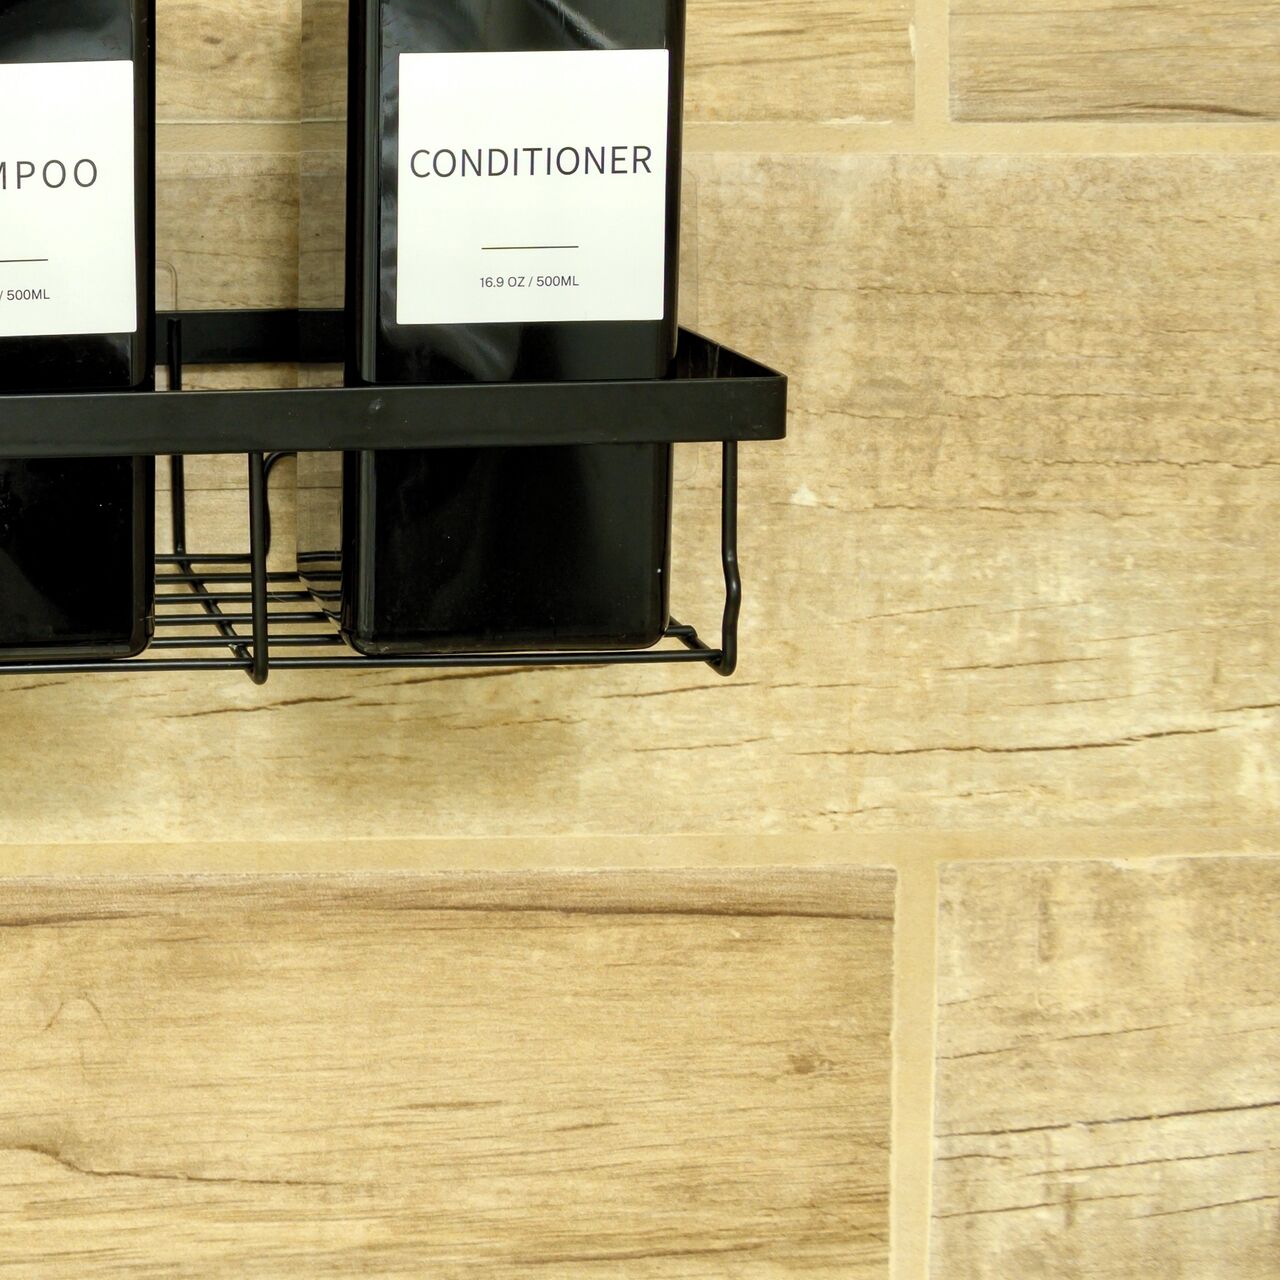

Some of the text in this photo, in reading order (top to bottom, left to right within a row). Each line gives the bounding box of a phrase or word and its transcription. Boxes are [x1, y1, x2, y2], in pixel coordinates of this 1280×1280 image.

[410, 145, 652, 179] CONDITIONER
[479, 276, 505, 288] 16.9
[507, 276, 526, 288] OZ
[536, 275, 580, 287] 500ML
[6, 288, 51, 301] 500ML
